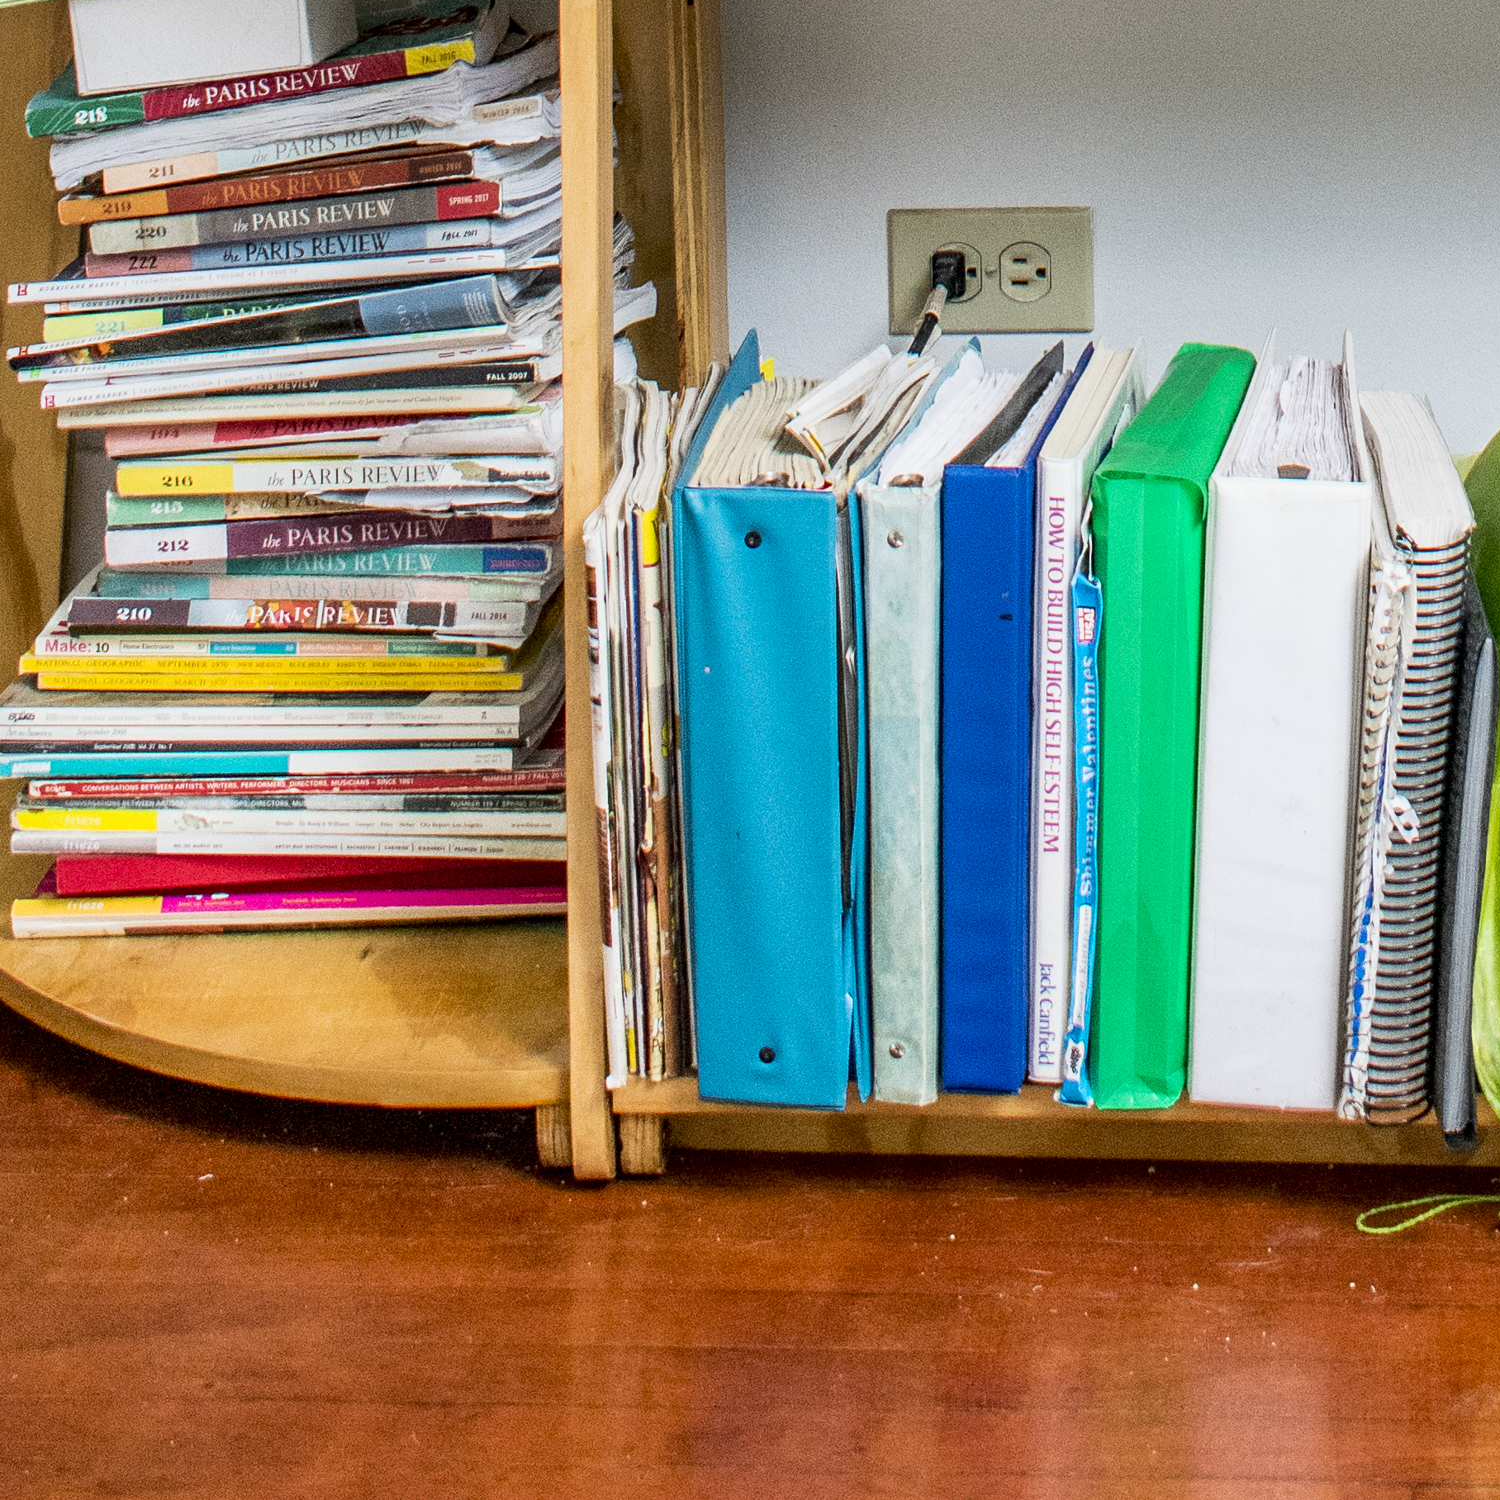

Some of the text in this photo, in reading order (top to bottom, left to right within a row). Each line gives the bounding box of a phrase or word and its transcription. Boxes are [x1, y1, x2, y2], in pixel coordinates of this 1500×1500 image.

[75, 64, 360, 124] 218 the PARIS REVIEW
[486, 372, 528, 381] FALL 2007
[162, 465, 444, 488] 216 the PARIS REVIEW
[45, 640, 109, 654] Make: 10
[1043, 496, 1065, 853] HOW TO BUILD HIGH SELF-ESTEEM
